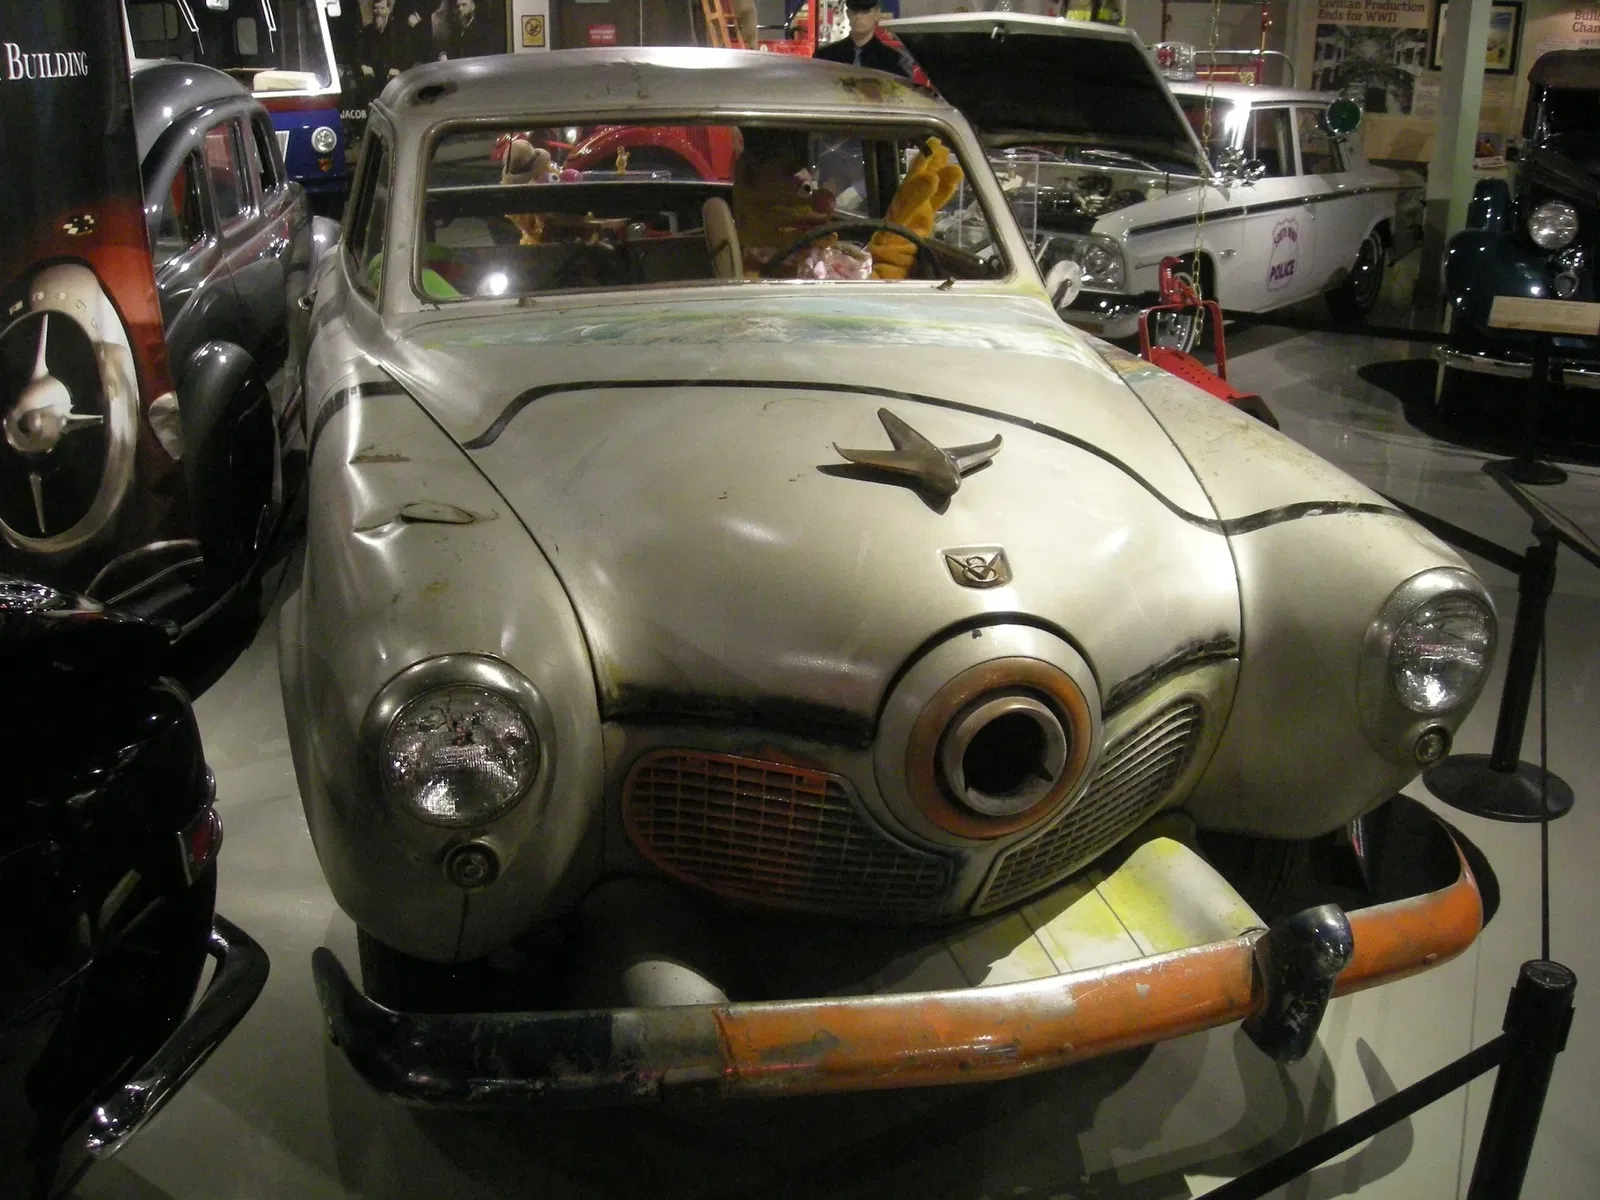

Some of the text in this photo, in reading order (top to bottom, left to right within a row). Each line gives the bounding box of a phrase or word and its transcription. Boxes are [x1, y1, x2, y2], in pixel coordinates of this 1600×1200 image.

[1365, 0, 1424, 12] Production
[1318, 9, 1397, 22] Ends for WWII
[3, 42, 89, 80] BUILDING
[340, 109, 367, 119] JACOB
[1269, 259, 1295, 282] POLICE
